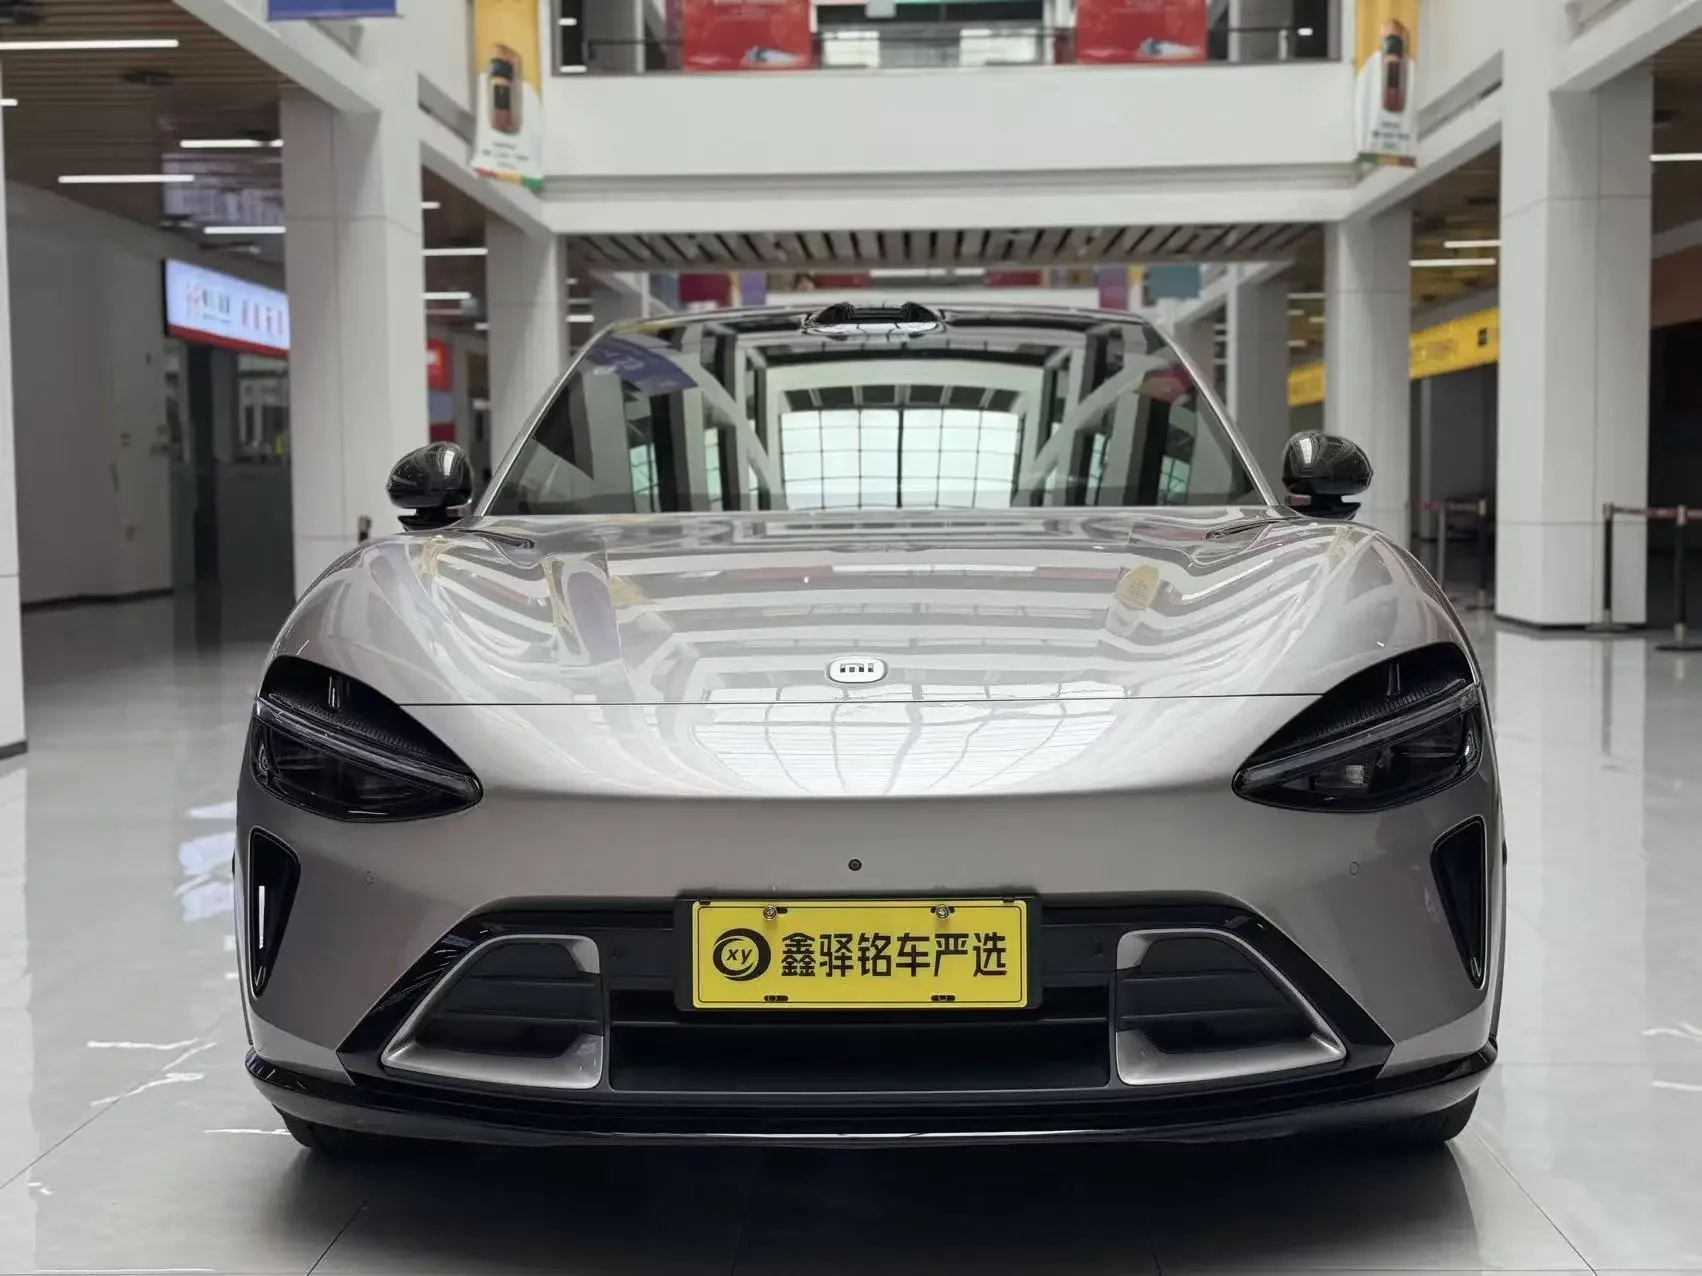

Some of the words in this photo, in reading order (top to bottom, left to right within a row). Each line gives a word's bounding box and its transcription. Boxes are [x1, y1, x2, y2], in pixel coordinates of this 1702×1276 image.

[781, 931, 1008, 978] 鑫驿铭车严选
